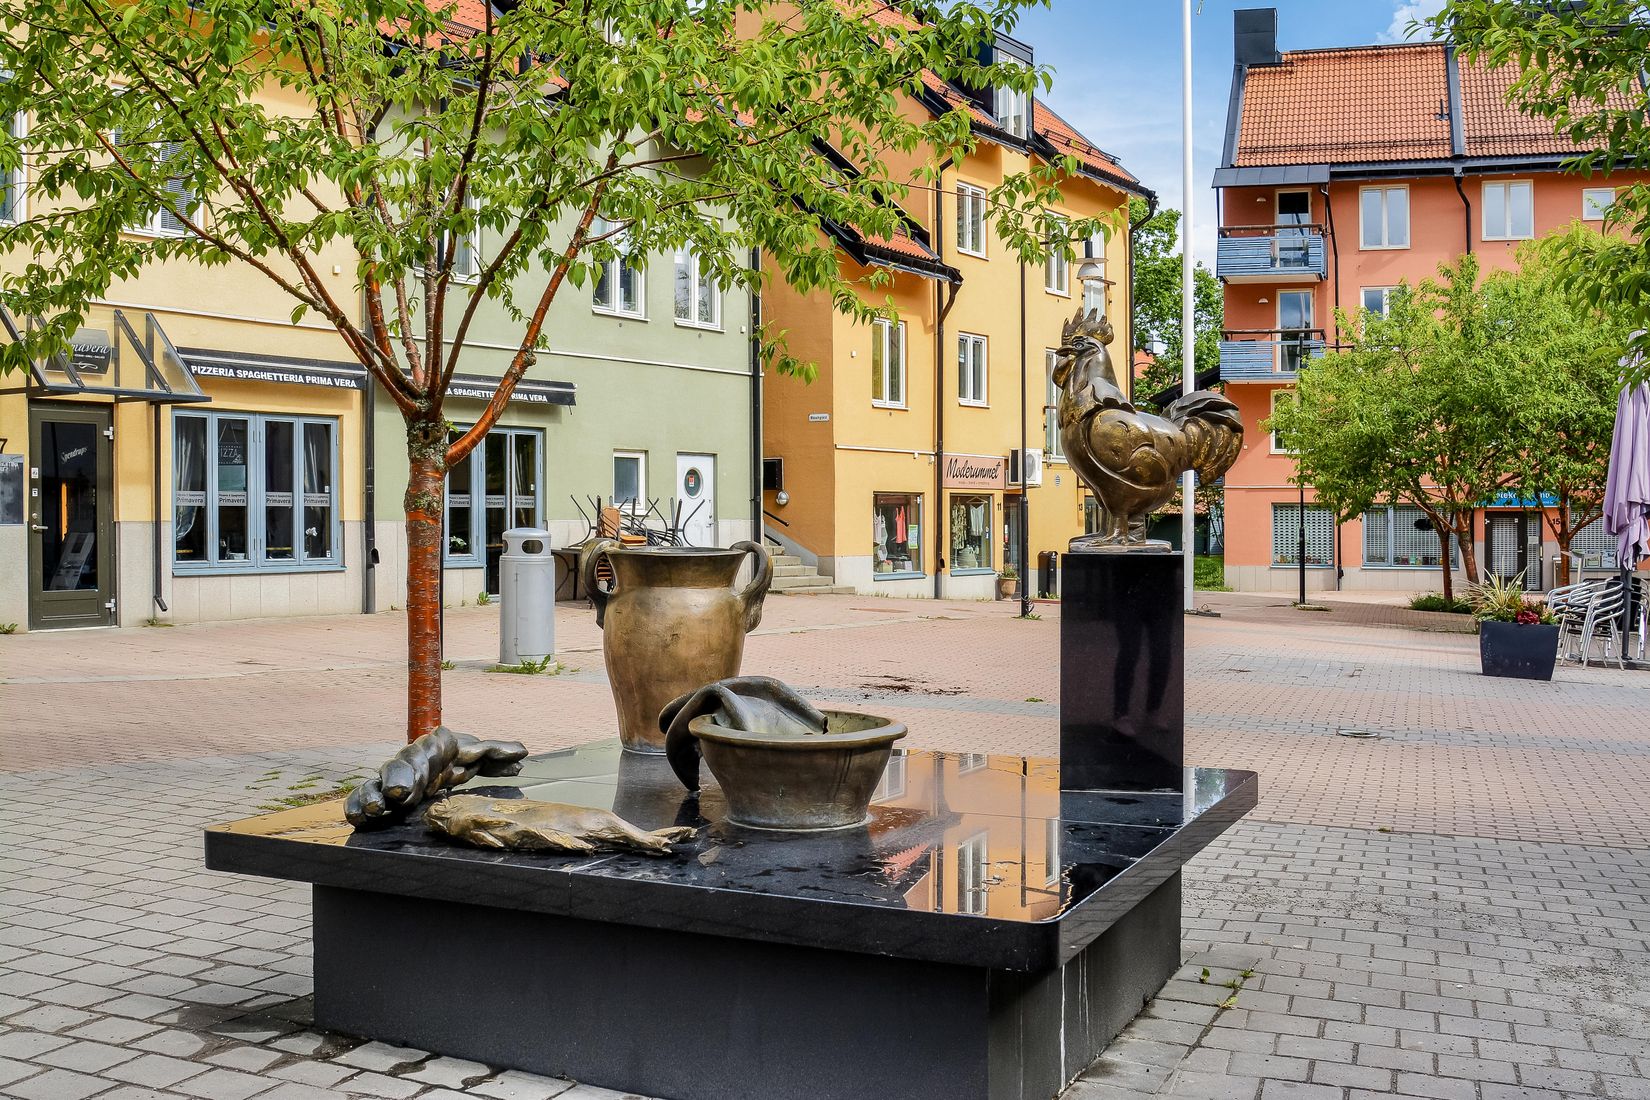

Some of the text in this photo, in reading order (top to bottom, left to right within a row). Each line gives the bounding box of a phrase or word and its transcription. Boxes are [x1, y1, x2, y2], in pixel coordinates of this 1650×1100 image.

[190, 365, 357, 388] PIZZERIA SPAGHETTERIA PRIMA VERA
[453, 388, 495, 398] SPAGHETTE
[511, 392, 529, 401] RIMA
[529, 394, 548, 402] VERA
[946, 458, 1001, 480] Moderummet
[176, 496, 204, 504] Primavera
